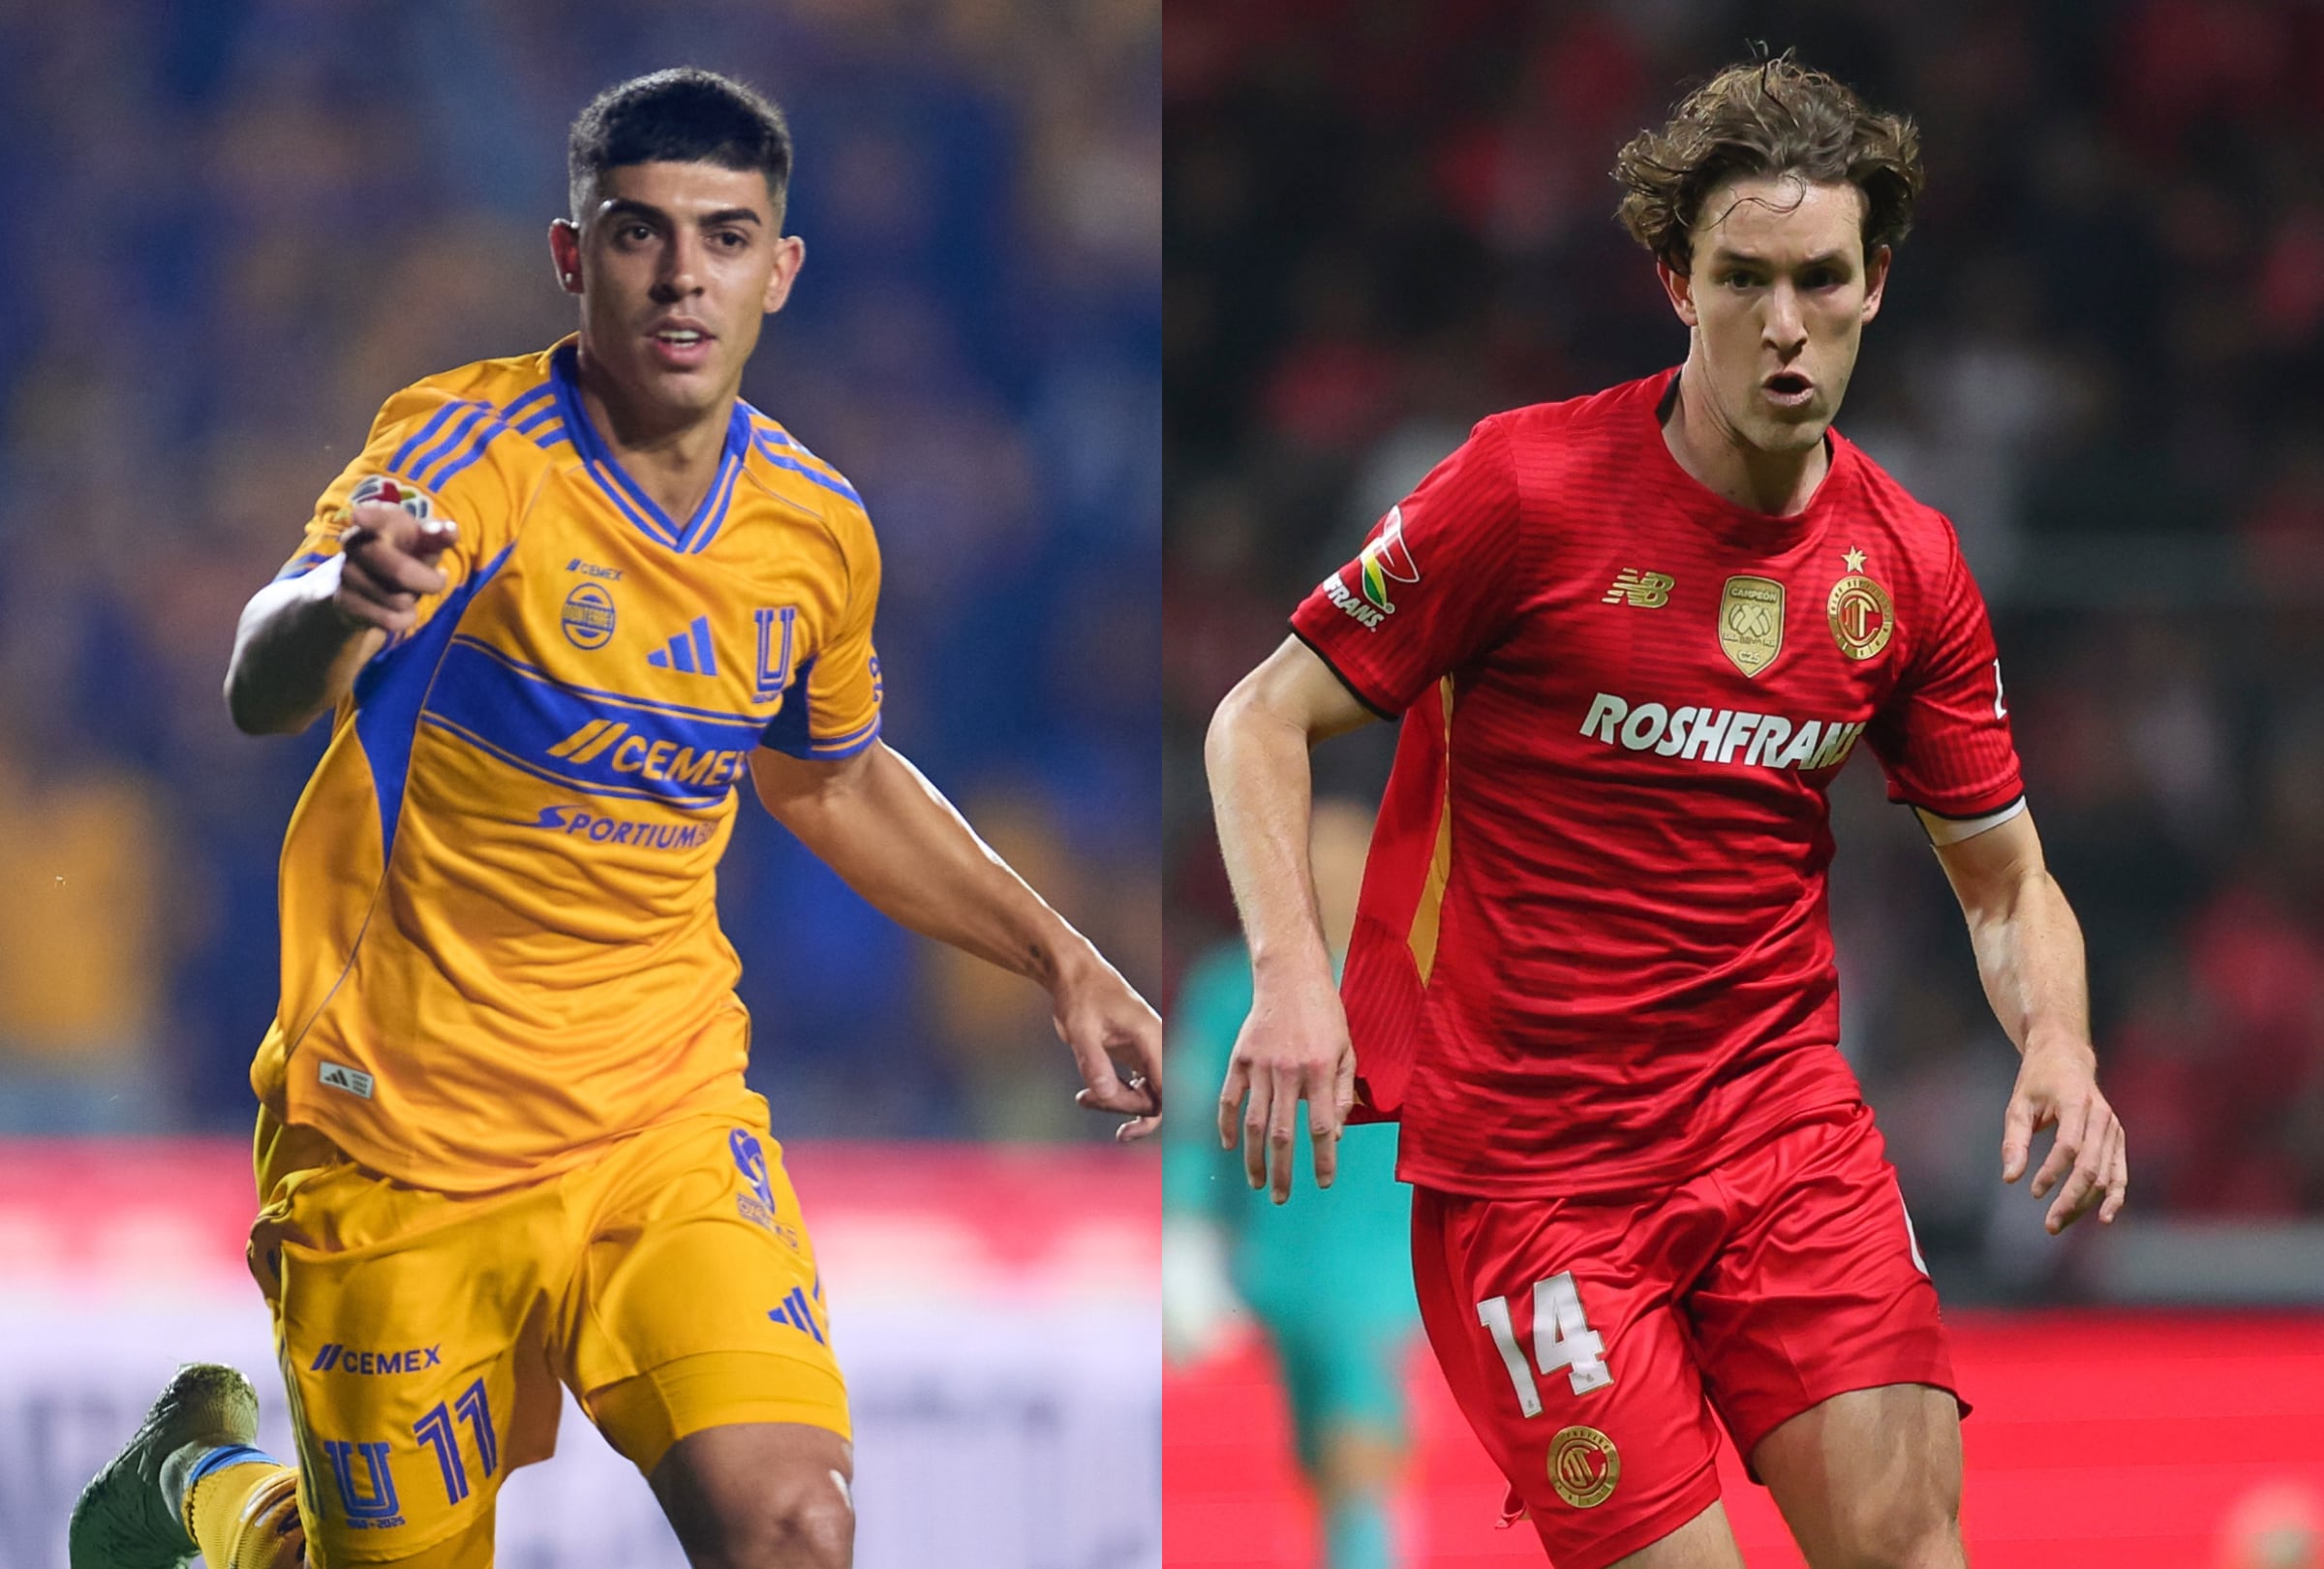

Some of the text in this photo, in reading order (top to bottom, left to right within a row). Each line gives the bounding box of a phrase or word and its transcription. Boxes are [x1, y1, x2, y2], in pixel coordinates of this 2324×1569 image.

[1729, 586, 1778, 603] CAMPEÓN
[343, 1343, 442, 1375] CEMEX
[1477, 1270, 1615, 1419] 14
[413, 1376, 498, 1506] 11
